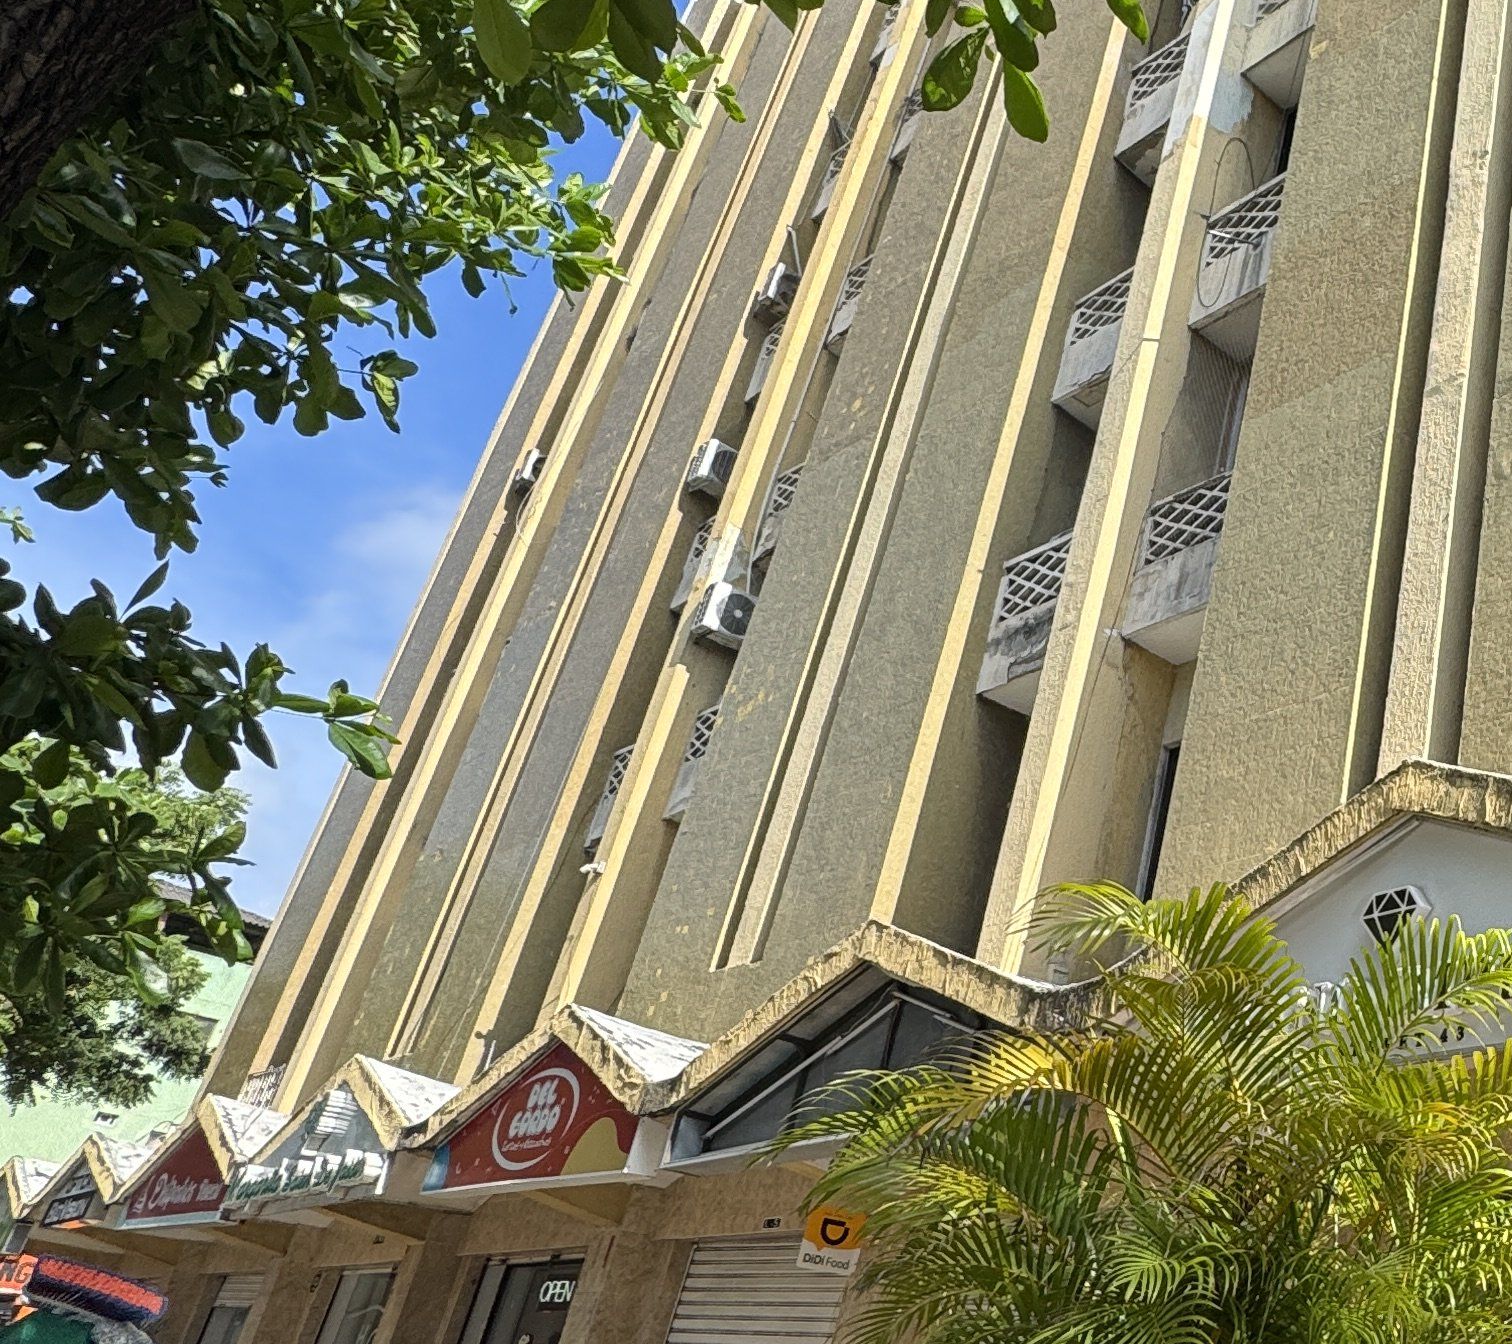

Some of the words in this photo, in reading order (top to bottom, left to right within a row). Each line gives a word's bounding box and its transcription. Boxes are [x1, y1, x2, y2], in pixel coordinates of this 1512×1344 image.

[526, 1077, 560, 1110] DEL
[802, 1252, 825, 1266] DiDi
[826, 1256, 850, 1270] Food
[539, 1280, 576, 1303] OPEN
